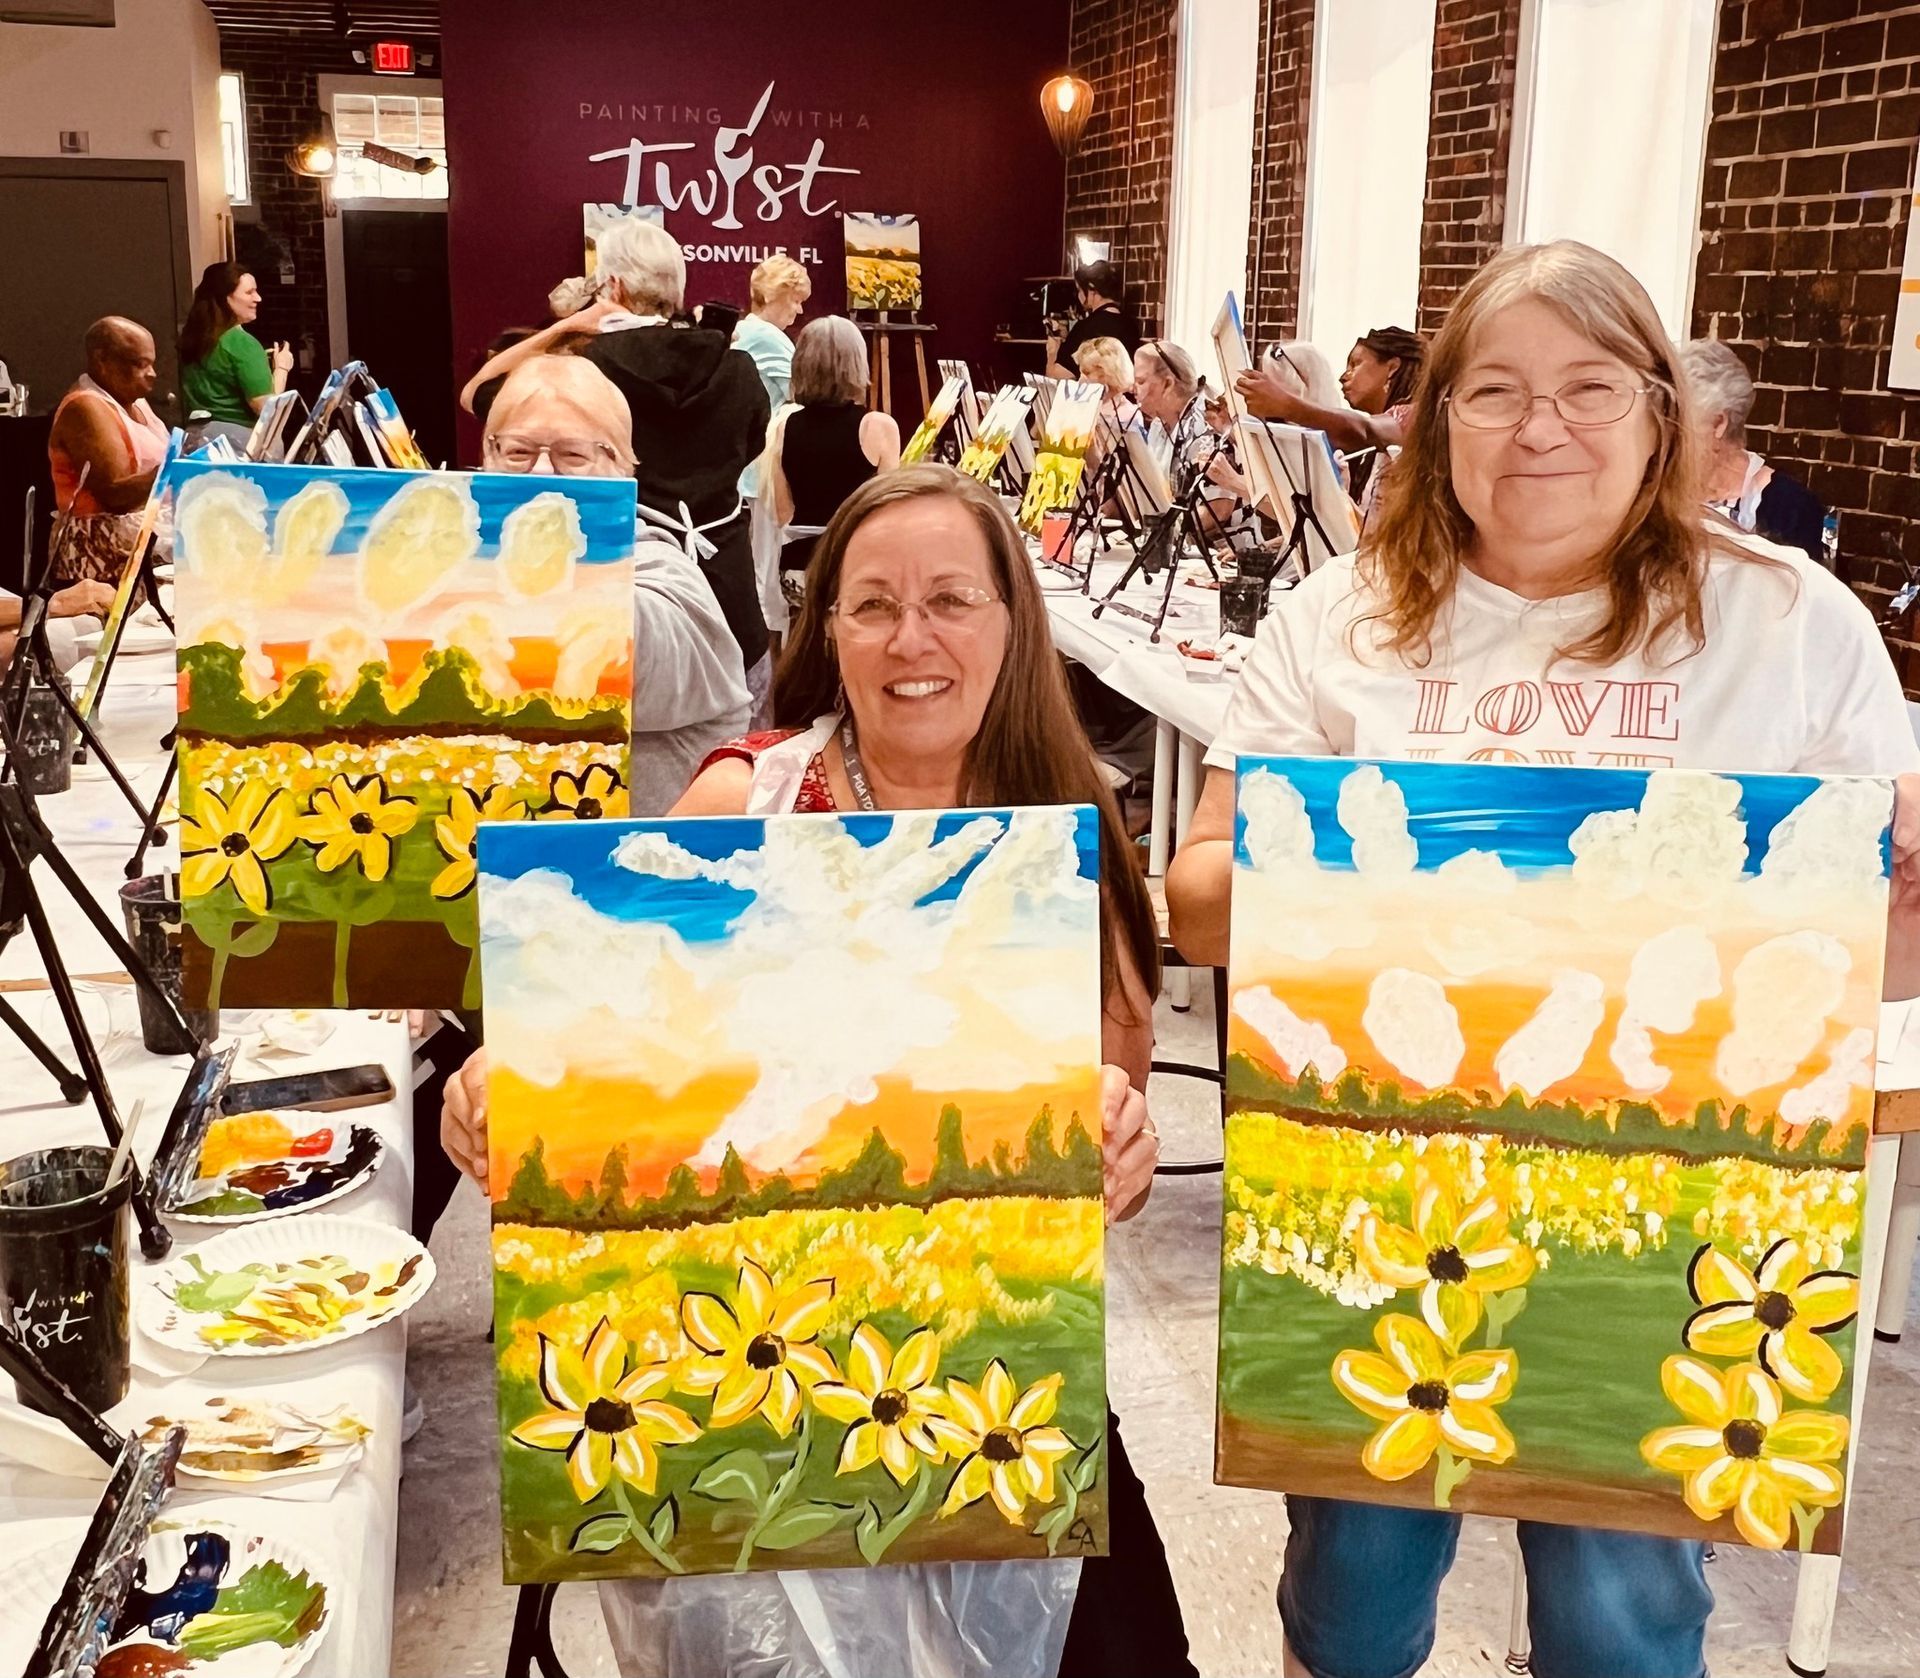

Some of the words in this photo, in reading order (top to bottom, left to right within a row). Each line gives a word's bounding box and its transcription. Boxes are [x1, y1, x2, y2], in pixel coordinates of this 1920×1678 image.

[377, 43, 410, 69] EXIT
[579, 102, 722, 125] PAINTING
[770, 109, 843, 129] WITH
[855, 113, 871, 130] A
[682, 244, 788, 263] SONVILLE
[799, 247, 823, 264] FL
[1408, 679, 1680, 741] LOVE
